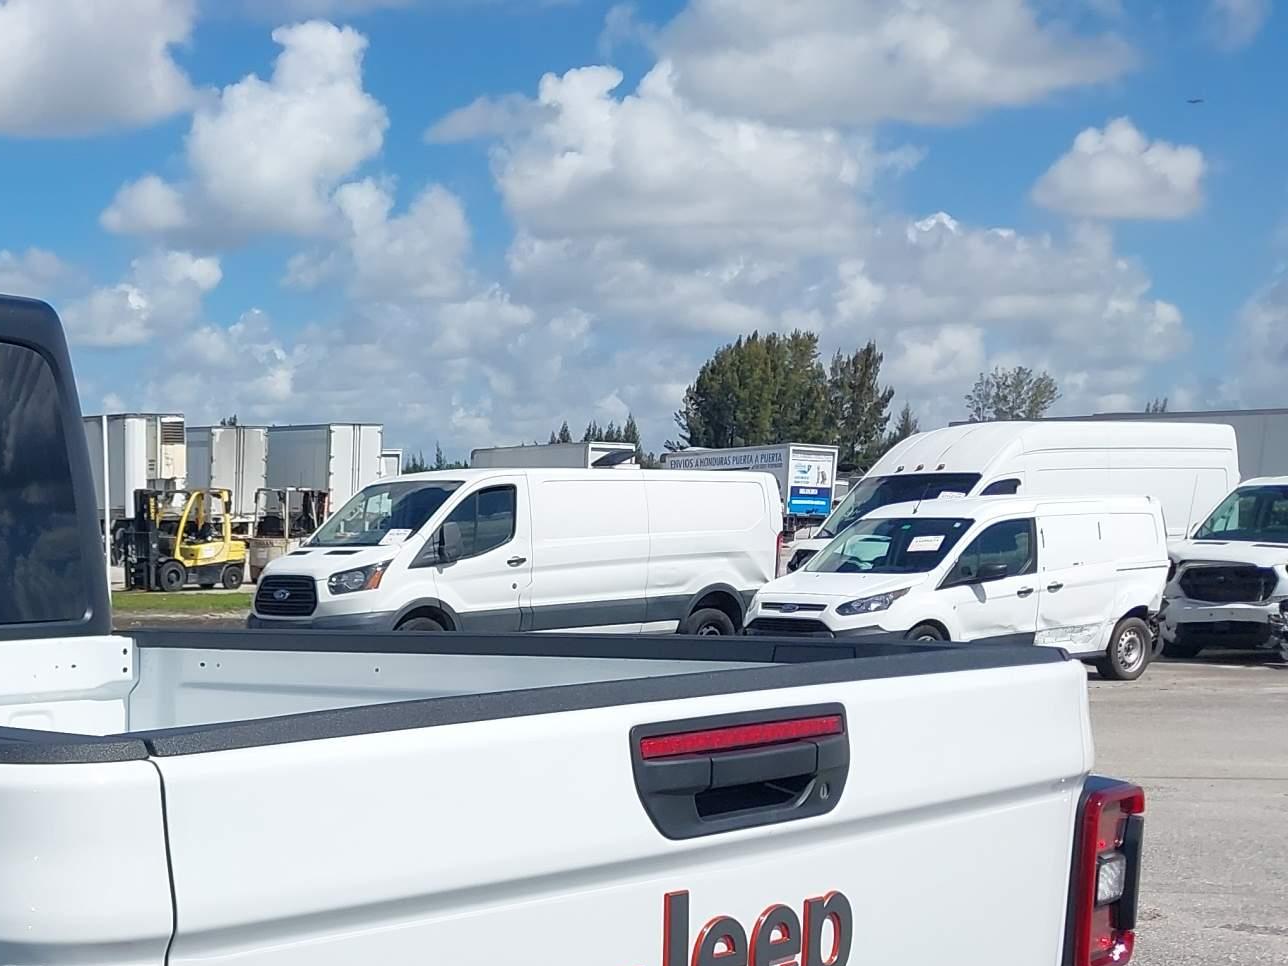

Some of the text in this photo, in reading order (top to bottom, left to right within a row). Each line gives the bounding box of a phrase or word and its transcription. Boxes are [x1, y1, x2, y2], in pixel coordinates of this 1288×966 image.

[700, 455, 731, 468] HONDURAS
[731, 454, 753, 465] PUERTA
[760, 452, 782, 463] PUERTA
